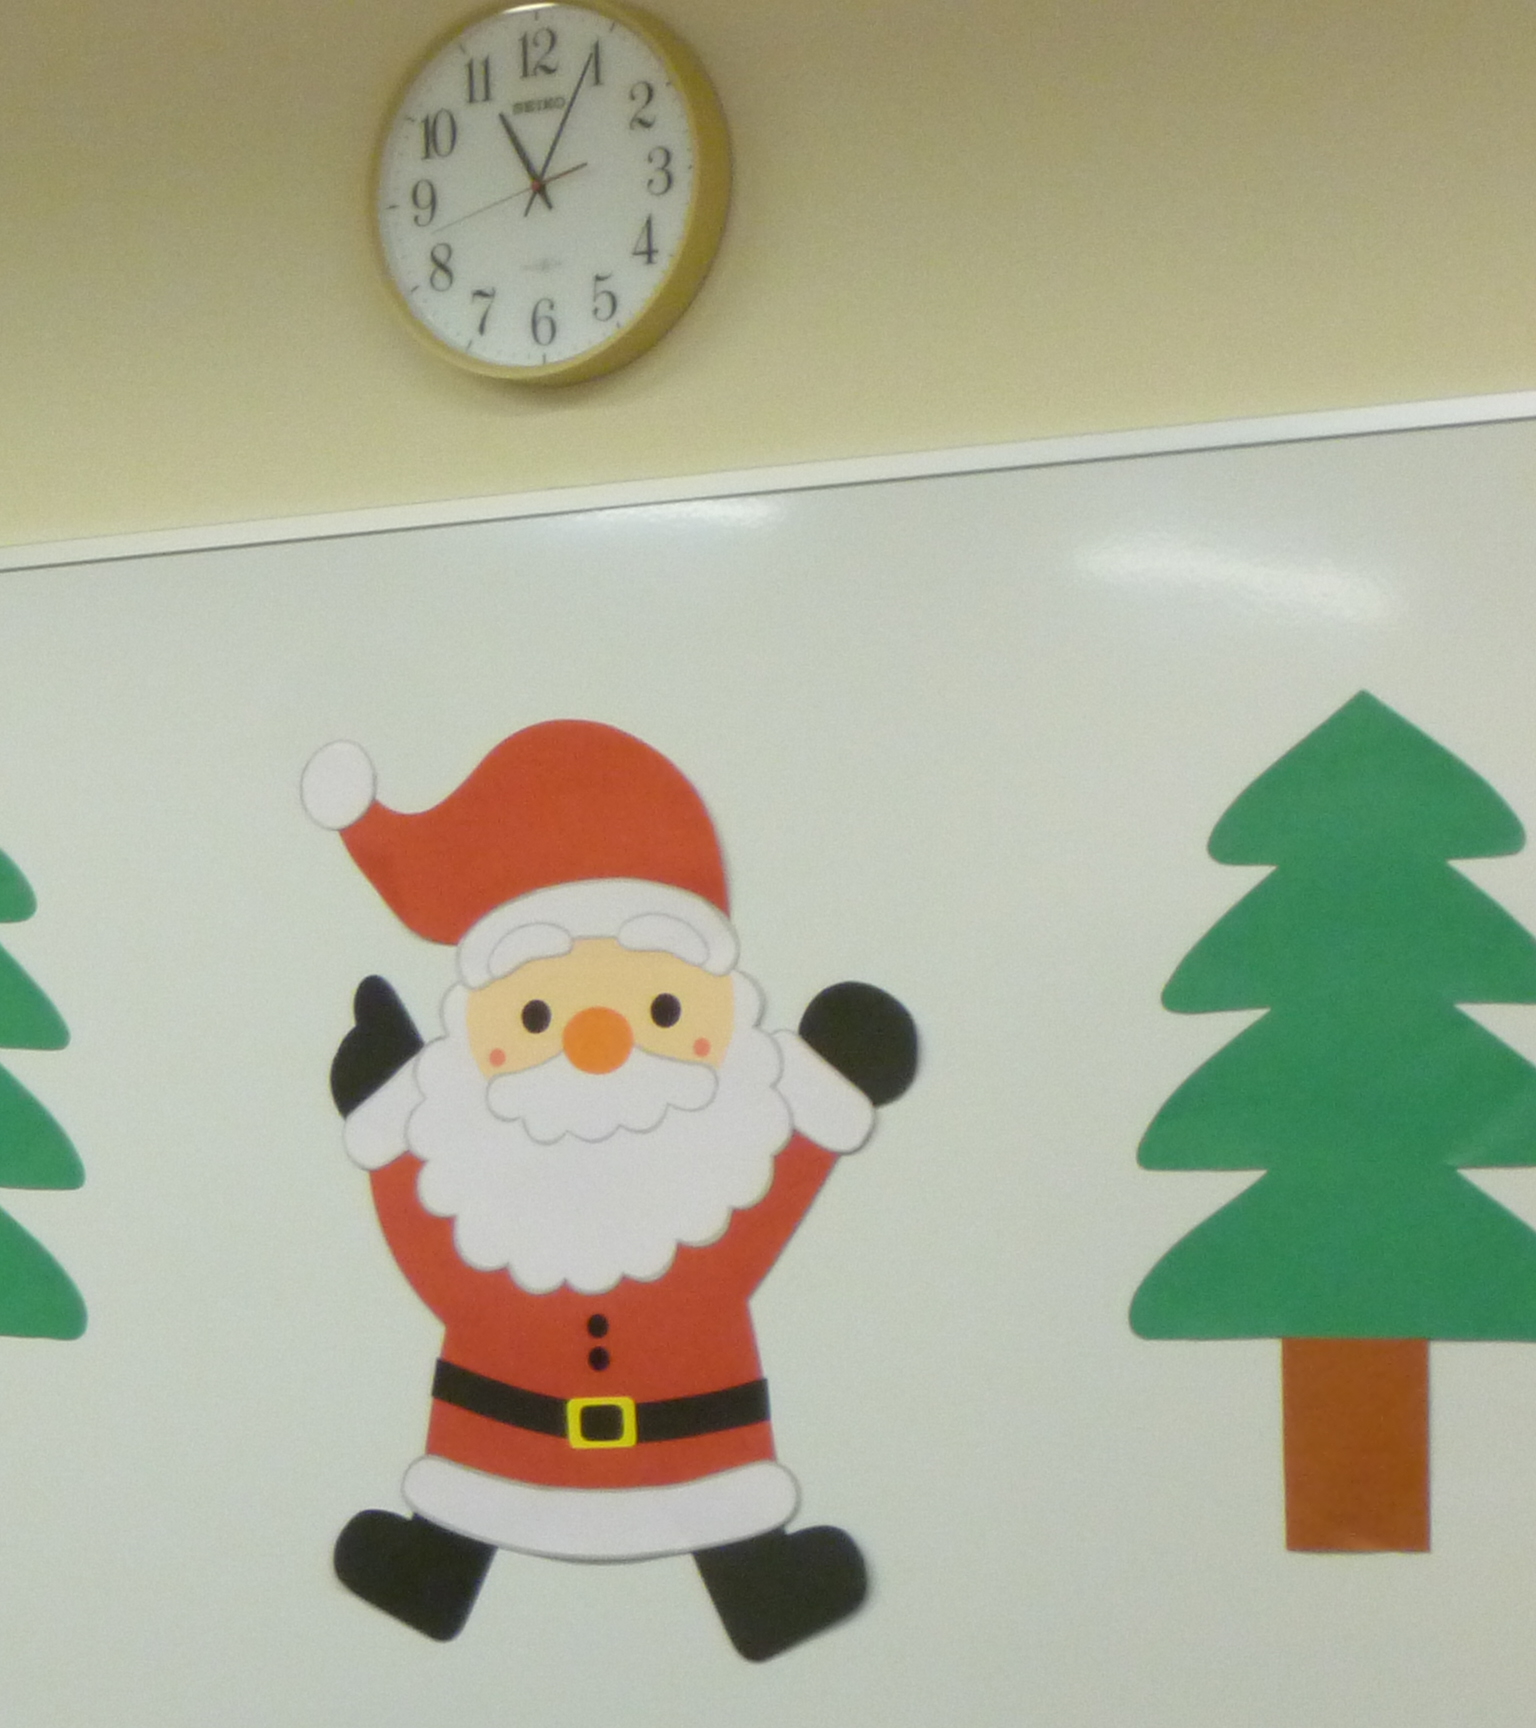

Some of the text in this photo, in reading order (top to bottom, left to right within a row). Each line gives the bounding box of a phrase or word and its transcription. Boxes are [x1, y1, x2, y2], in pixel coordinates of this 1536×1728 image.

[518, 27, 557, 79] 12
[591, 39, 604, 86] 1
[465, 55, 491, 104] 11
[629, 80, 656, 130] 2
[421, 107, 458, 160] 10
[646, 146, 672, 196] 3
[411, 178, 437, 227] 9
[631, 213, 659, 265] 4
[429, 242, 454, 292] 8
[471, 286, 496, 336] 7
[530, 297, 557, 345] 6
[592, 273, 618, 321] 5
